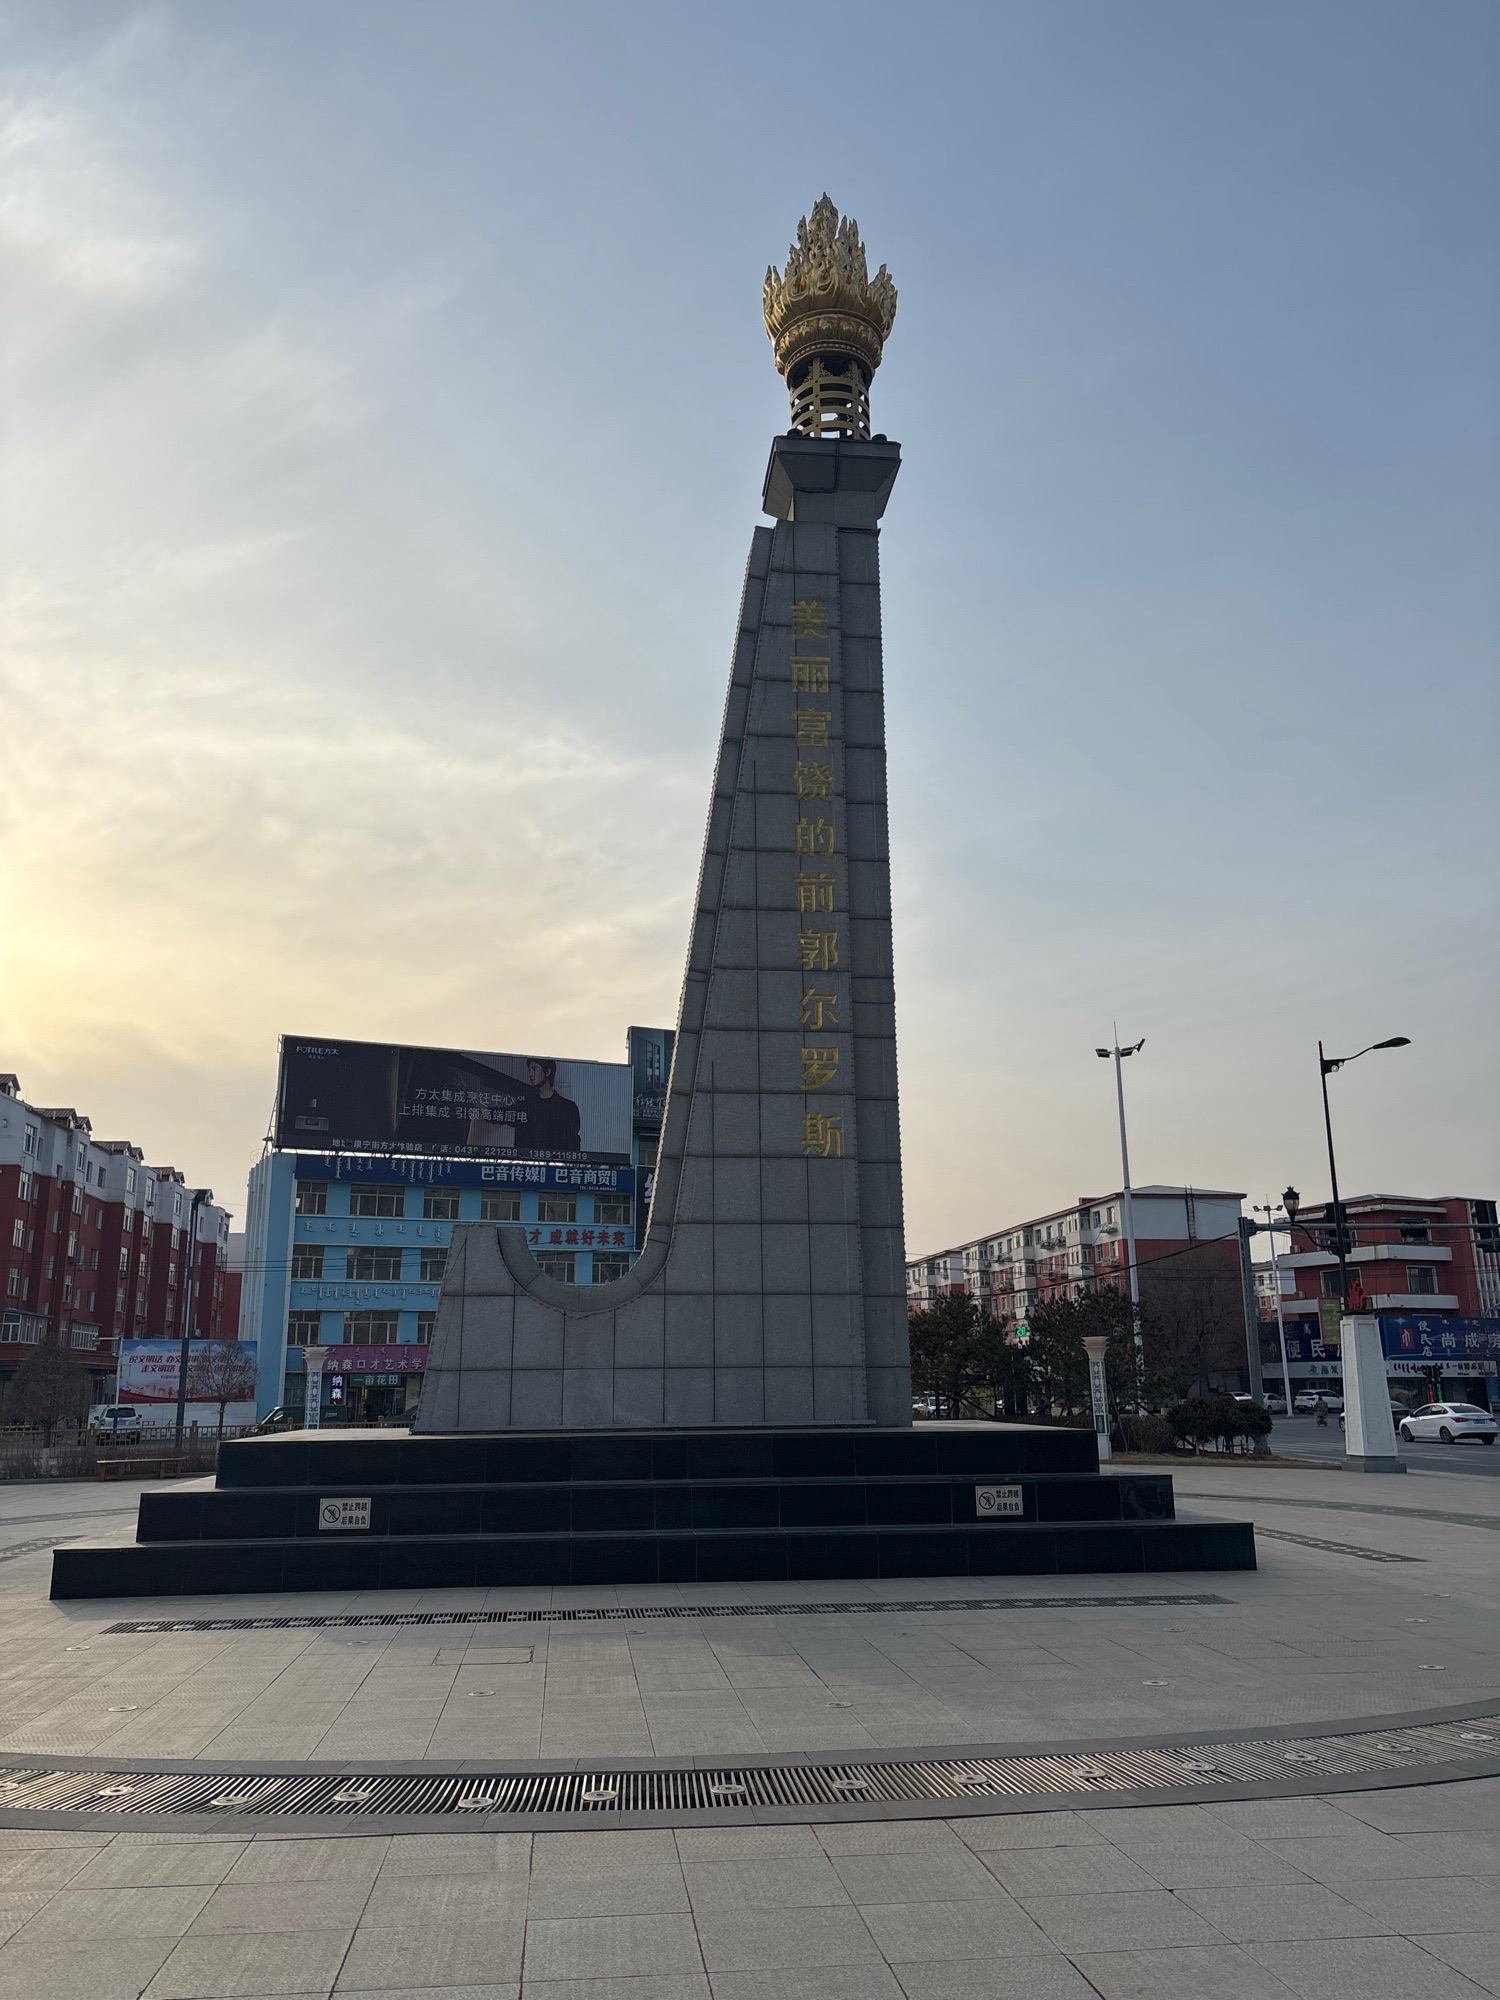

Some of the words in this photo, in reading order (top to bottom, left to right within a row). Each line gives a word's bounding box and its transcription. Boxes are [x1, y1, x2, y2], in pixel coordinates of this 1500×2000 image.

[790, 600, 844, 1158] 美丽富饶的前郭尔罗斯
[414, 1088, 514, 1107] 方太集成烹饪中心
[398, 1103, 450, 1118] 上排集成
[455, 1107, 528, 1123] 引领高端厨电
[481, 1165, 540, 1183] 巴音传媒
[555, 1168, 611, 1186] 巴音商贸
[549, 1228, 626, 1247] 成就好未来
[1417, 1320, 1433, 1357] 便民店
[1441, 1332, 1500, 1348] 尚成房
[1286, 1339, 1342, 1359] 便民
[128, 1354, 164, 1364] 说文明话
[326, 1358, 423, 1371] 纳森口才艺术学
[331, 1375, 343, 1400] 纳森
[353, 1374, 398, 1386] 一亩花田
[995, 1489, 1019, 1498] 禁止跨越
[341, 1502, 367, 1512] 禁止跨越
[996, 1502, 1020, 1512] 后果自负
[341, 1515, 366, 1525] 后果自负
